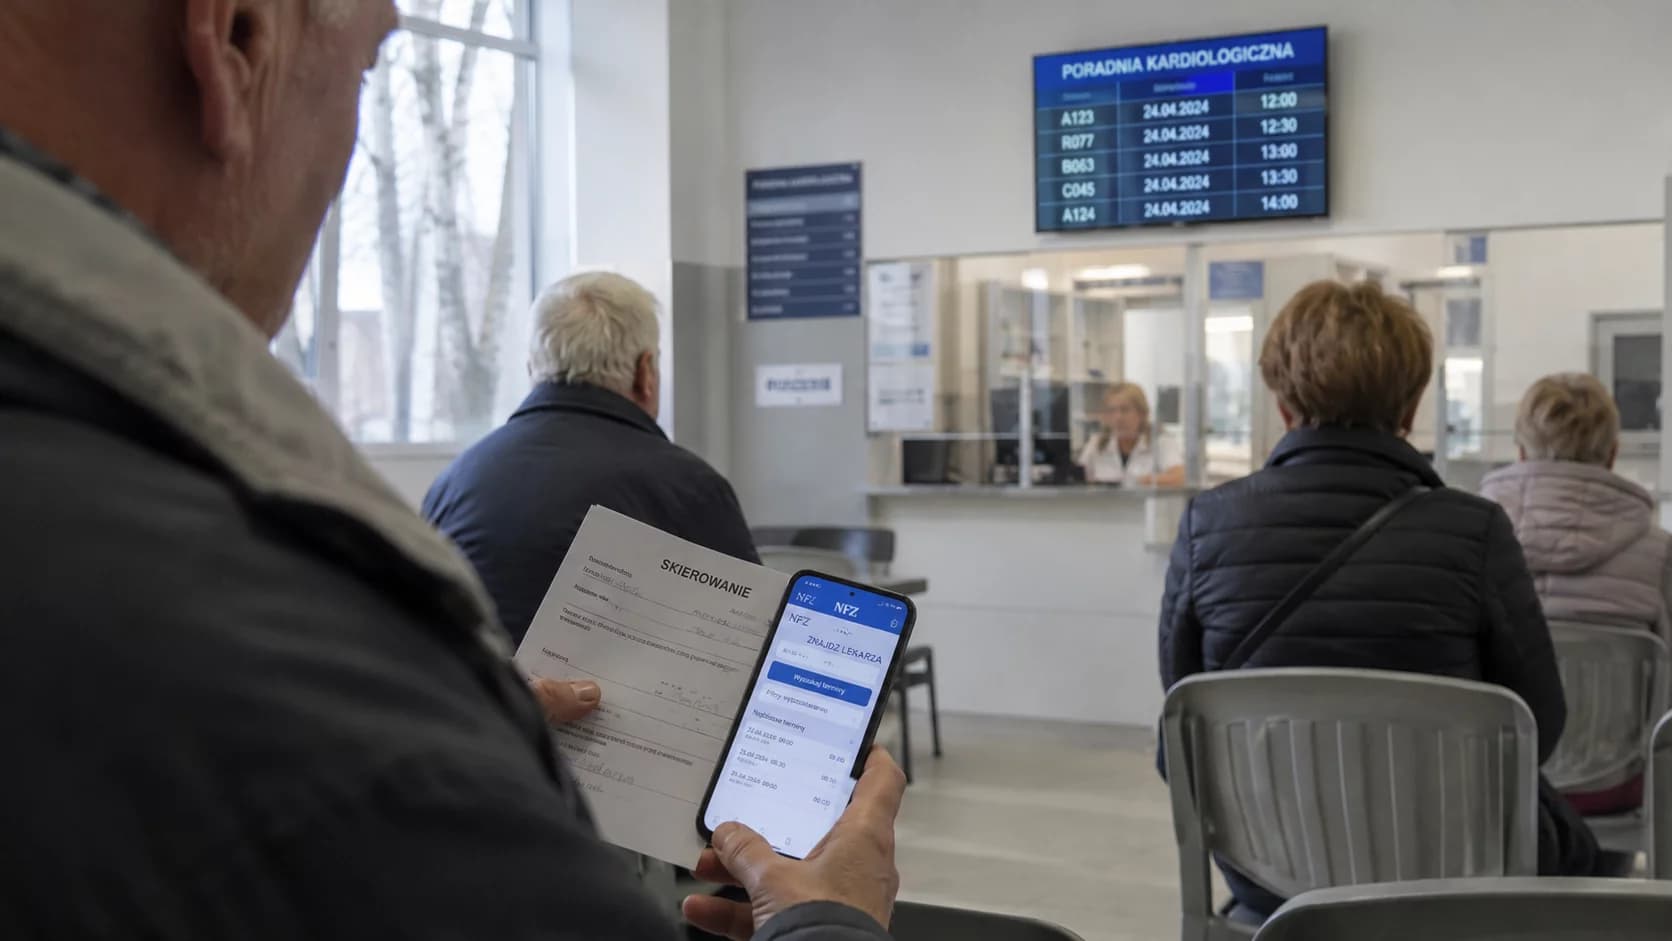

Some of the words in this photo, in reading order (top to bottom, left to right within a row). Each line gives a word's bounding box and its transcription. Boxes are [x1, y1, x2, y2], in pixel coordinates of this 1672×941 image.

[1062, 56, 1143, 79] PORADNIA
[1146, 42, 1295, 71] KARDIOLOGICZNA
[1061, 109, 1095, 126] A123
[1143, 99, 1209, 119] 24.04.2024
[1260, 92, 1298, 109] 12:00
[1061, 133, 1095, 150] R077
[1143, 125, 1209, 144] 24.04.2024
[1260, 117, 1298, 134] 12:30
[1144, 150, 1210, 168] 24.04.2024
[1261, 143, 1298, 160] 13:00
[1062, 182, 1095, 198] C045
[1144, 175, 1210, 193] 24.04.2024
[1261, 168, 1298, 186] 13:30
[1062, 207, 1096, 223] A124
[1144, 200, 1210, 218] 24.04.2024
[1261, 194, 1299, 211] 14:00
[660, 558, 752, 599] SKIEROWANIE
[788, 612, 811, 627] NFZ
[834, 601, 861, 618] NFZ
[842, 647, 882, 665] LEKARZA
